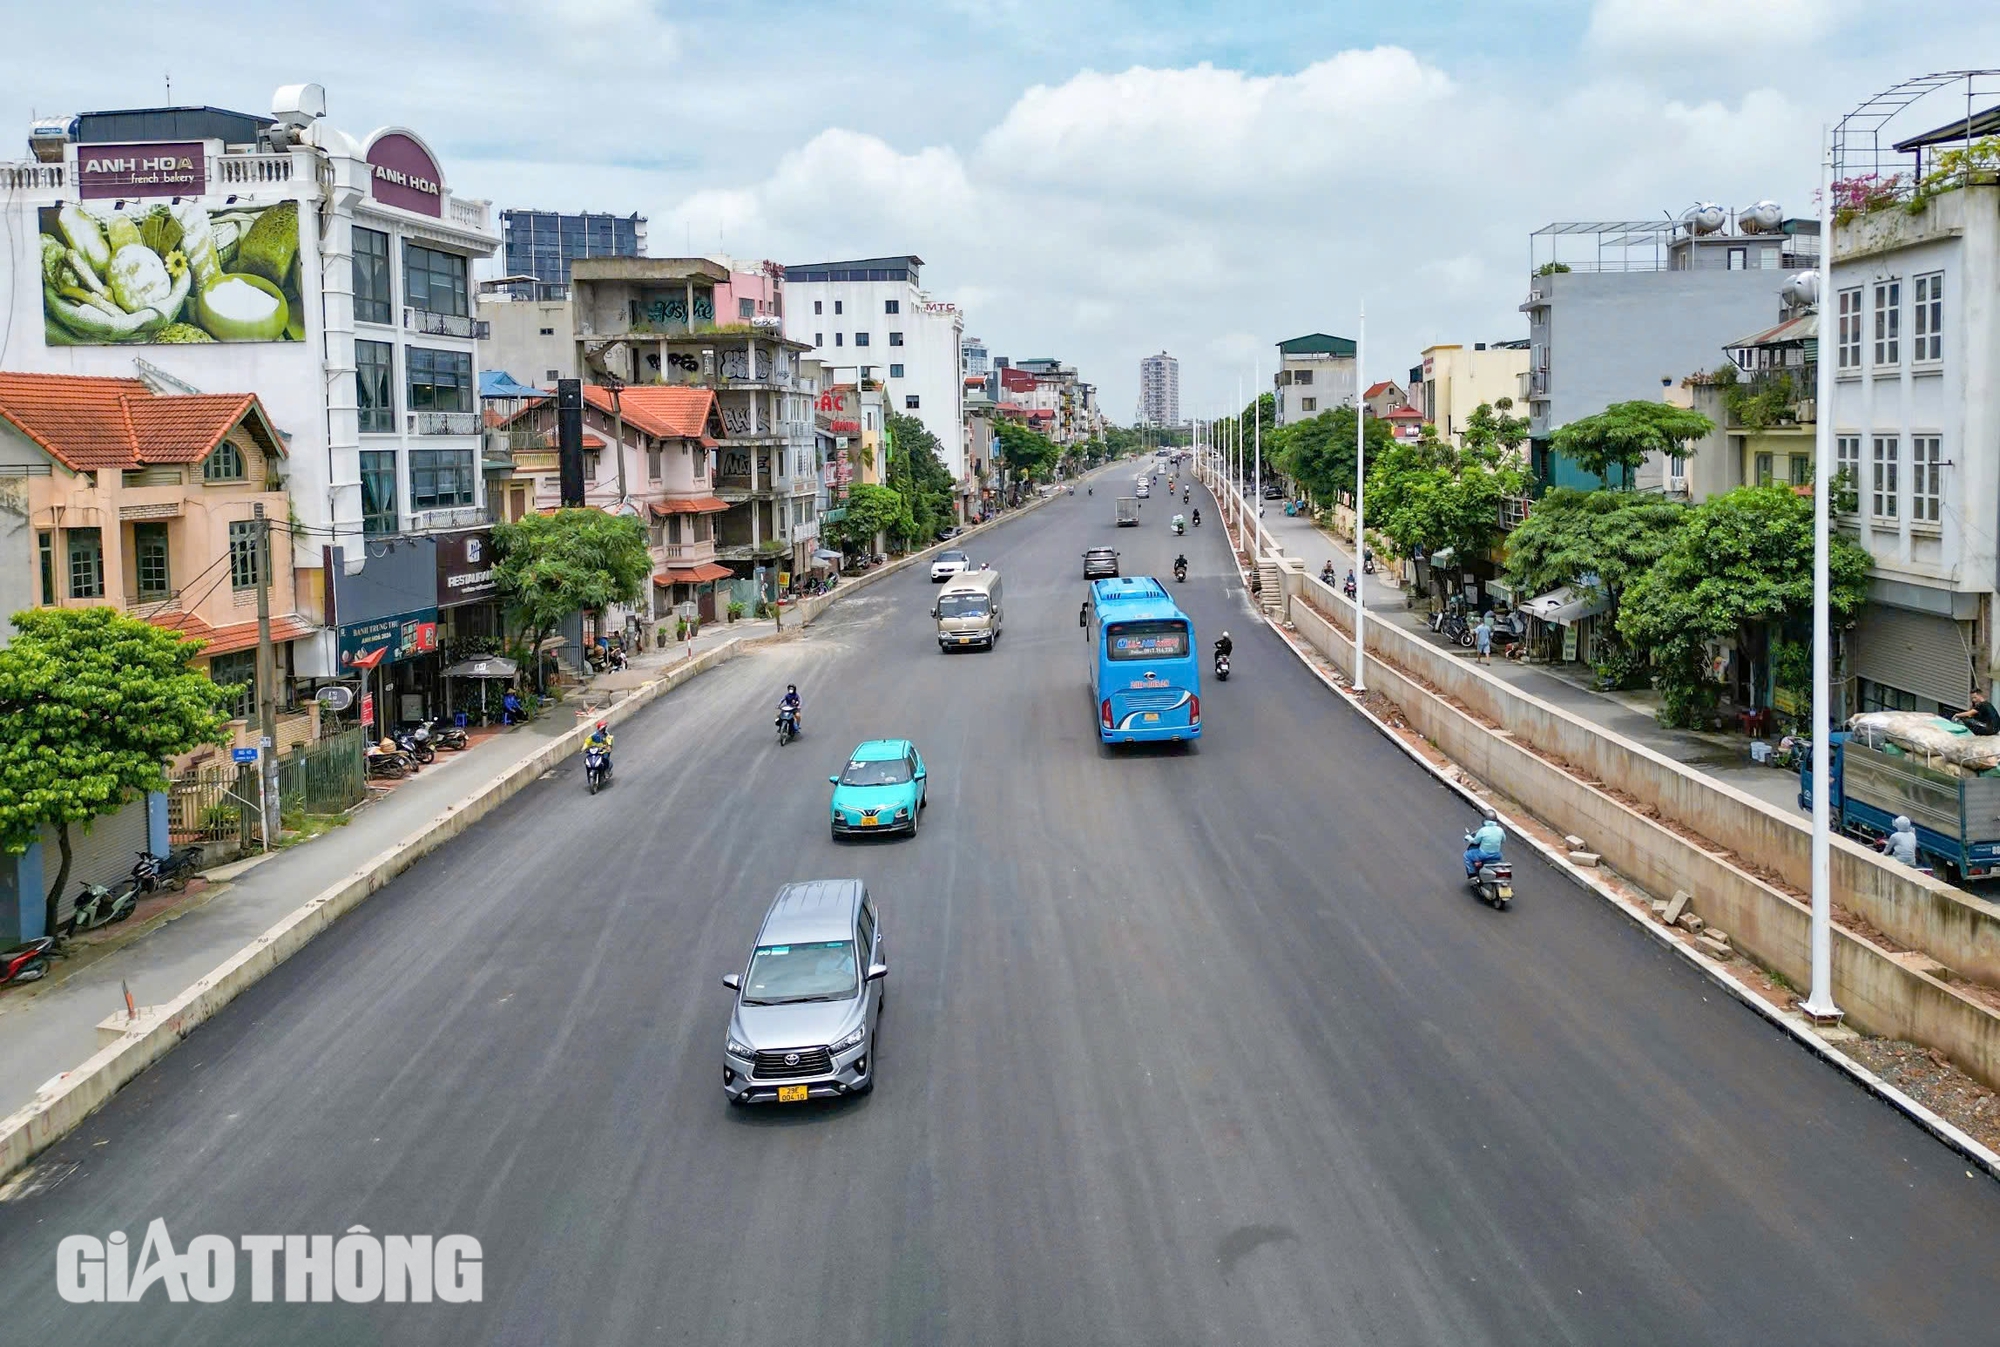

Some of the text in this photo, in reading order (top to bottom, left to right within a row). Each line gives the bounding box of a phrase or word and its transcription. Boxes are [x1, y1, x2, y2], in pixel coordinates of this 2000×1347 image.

[85, 158, 135, 173] ANH
[131, 171, 194, 184] french bakery
[376, 166, 406, 186] ANH
[926, 303, 956, 312] MTC
